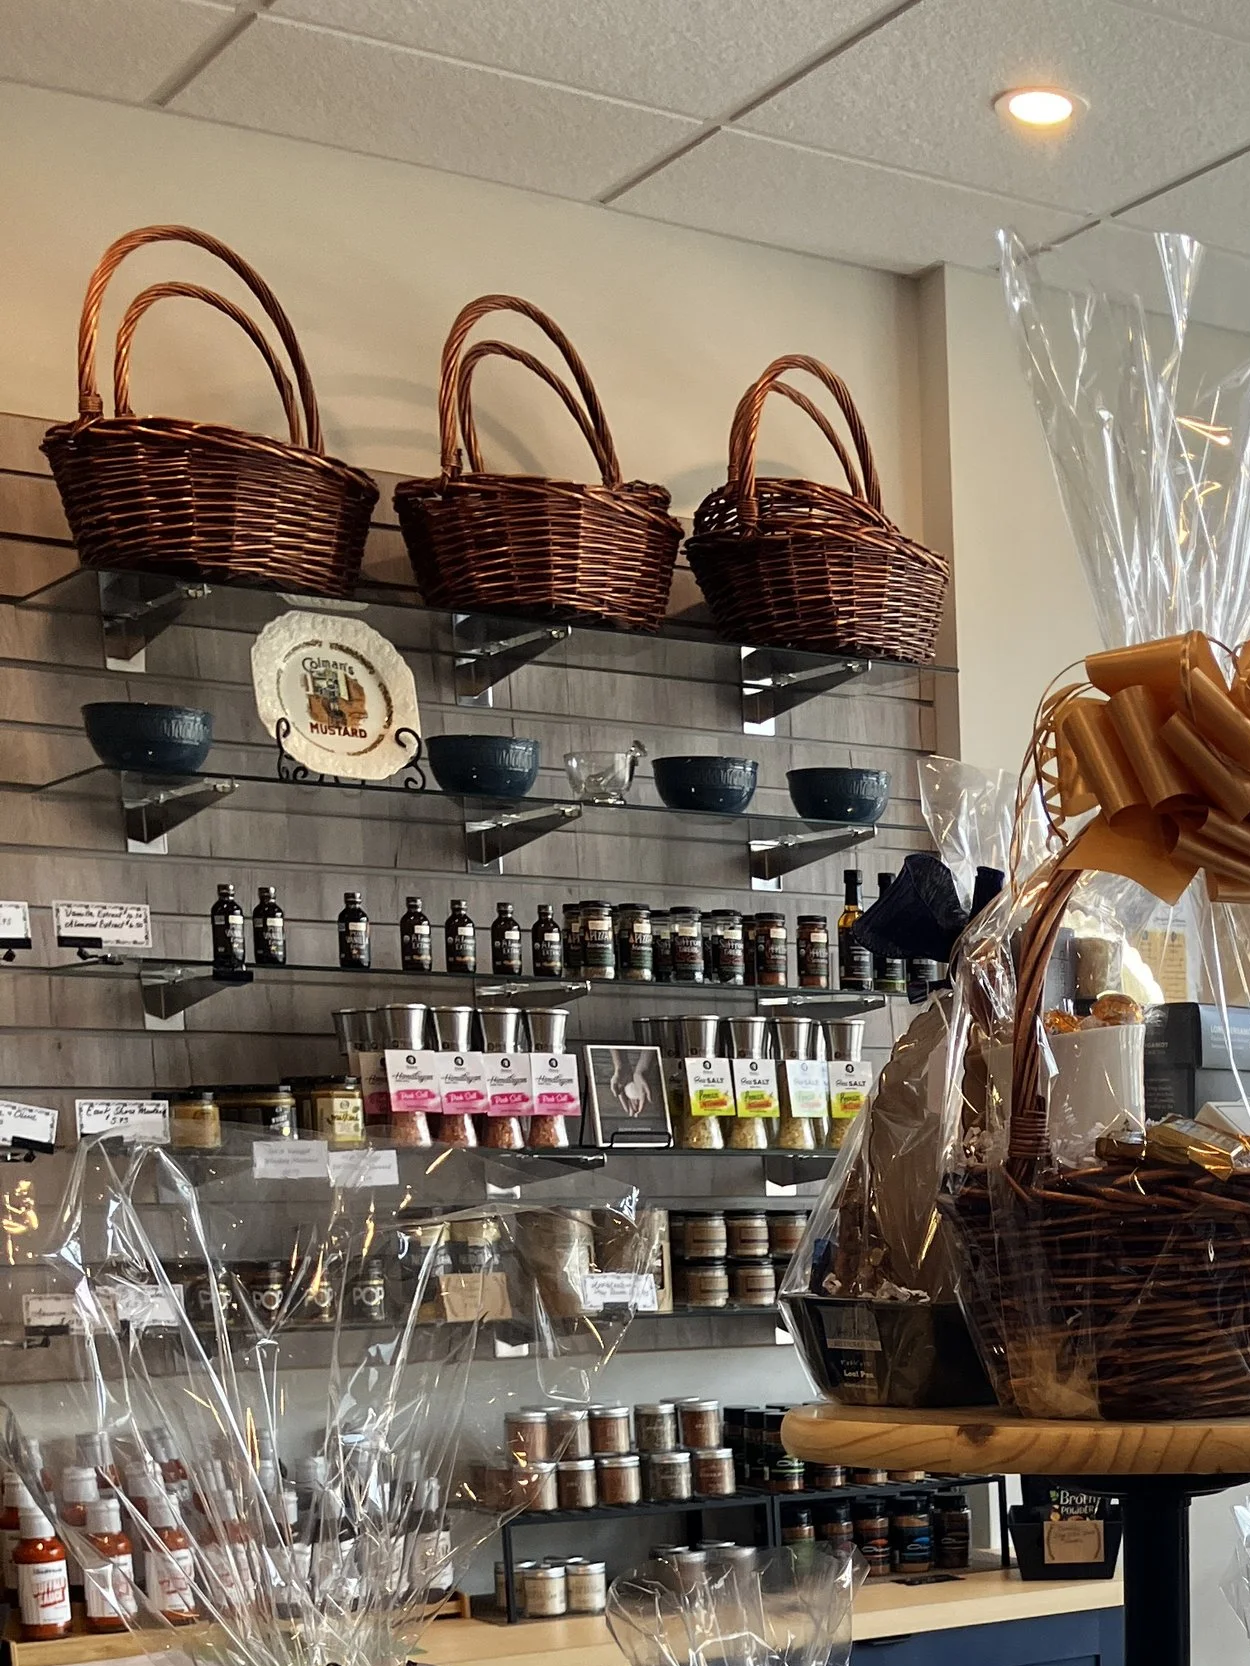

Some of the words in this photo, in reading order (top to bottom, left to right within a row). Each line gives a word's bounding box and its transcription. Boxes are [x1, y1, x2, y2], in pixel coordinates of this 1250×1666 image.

[302, 657, 355, 676] Colman's
[309, 722, 368, 739] MUSTARD
[252, 1289, 284, 1310] POP
[352, 1286, 385, 1306] POP
[1061, 1504, 1094, 1515] POWDER
